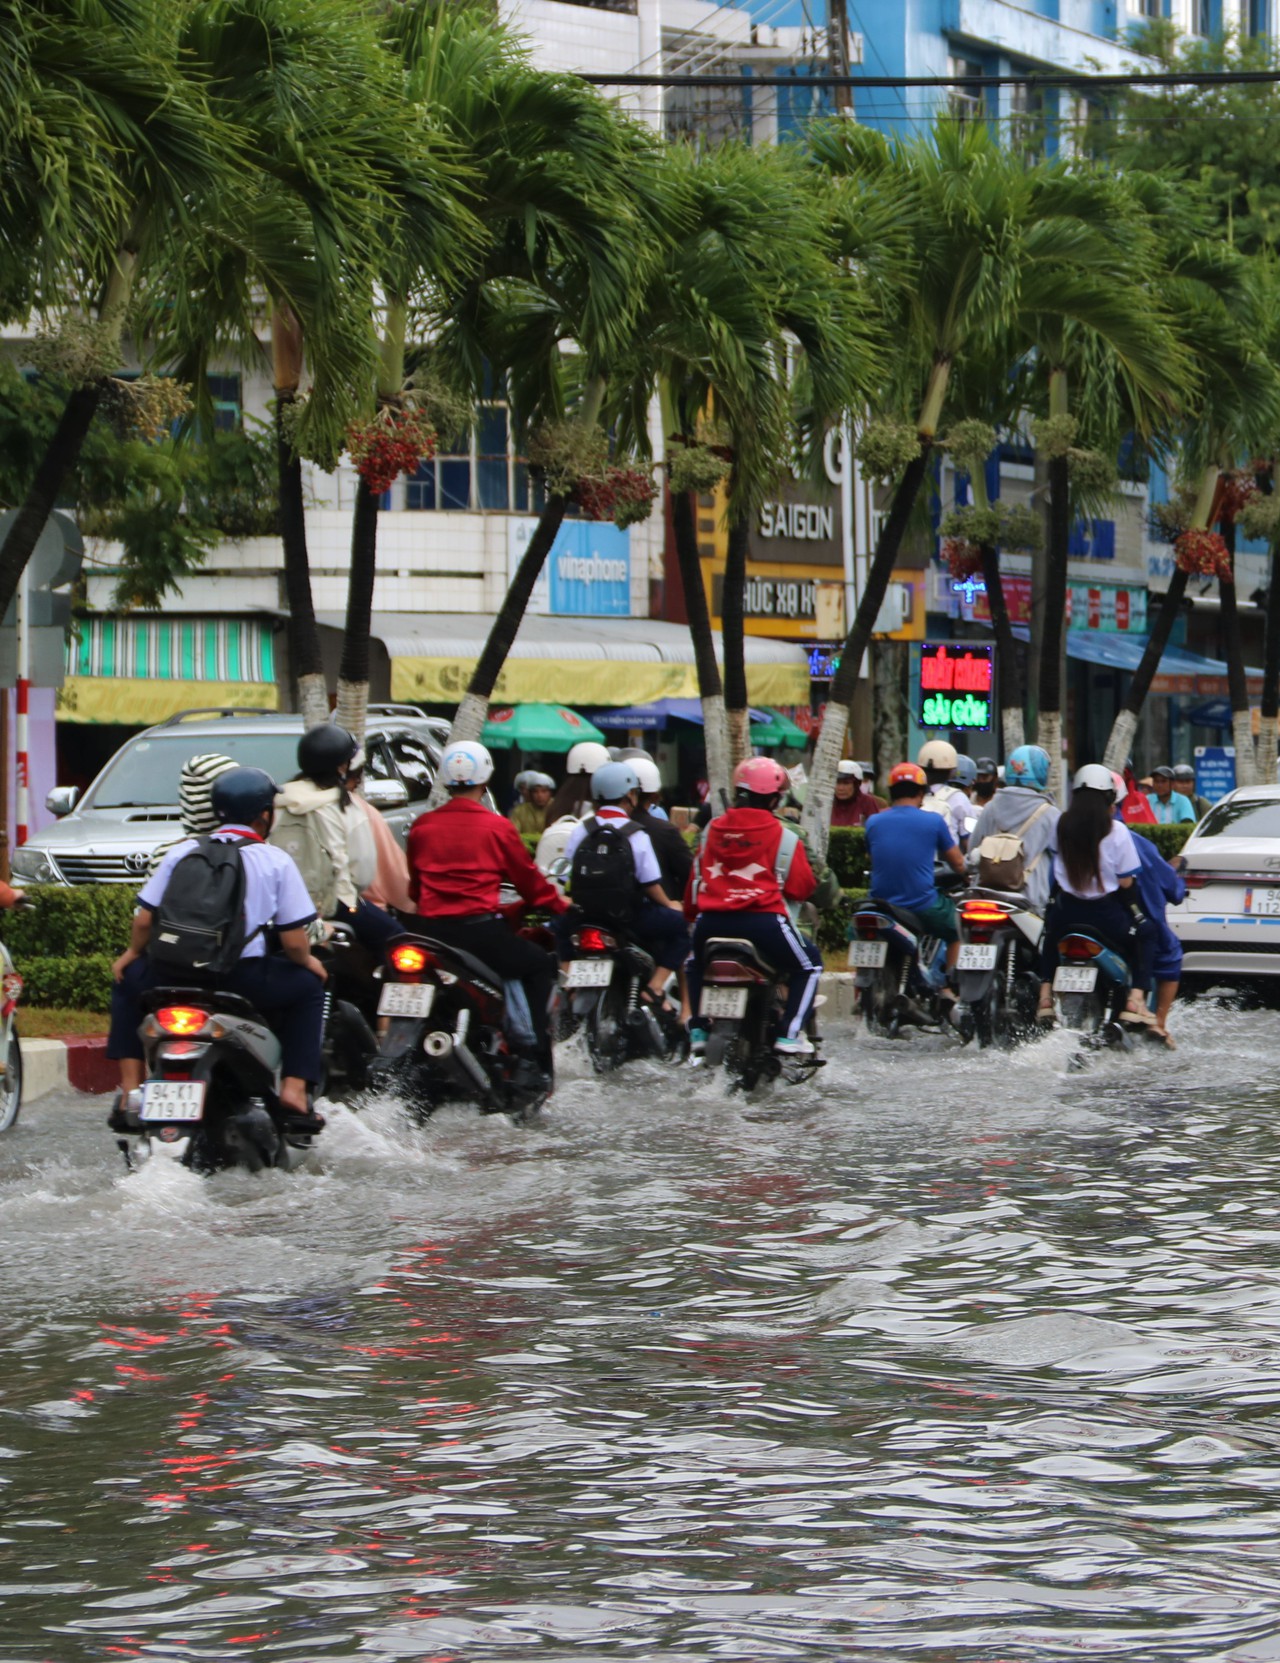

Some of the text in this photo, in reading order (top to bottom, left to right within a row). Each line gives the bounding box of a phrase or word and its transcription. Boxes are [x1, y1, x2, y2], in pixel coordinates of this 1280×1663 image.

[761, 502, 834, 541] SAIGON
[557, 550, 627, 587] vinaphone
[743, 576, 774, 613] HÚC
[776, 582, 799, 617] XẠ
[958, 957, 993, 968] 218.20
[151, 1083, 194, 1101] 94-K1
[143, 1101, 199, 1119] 719.12
